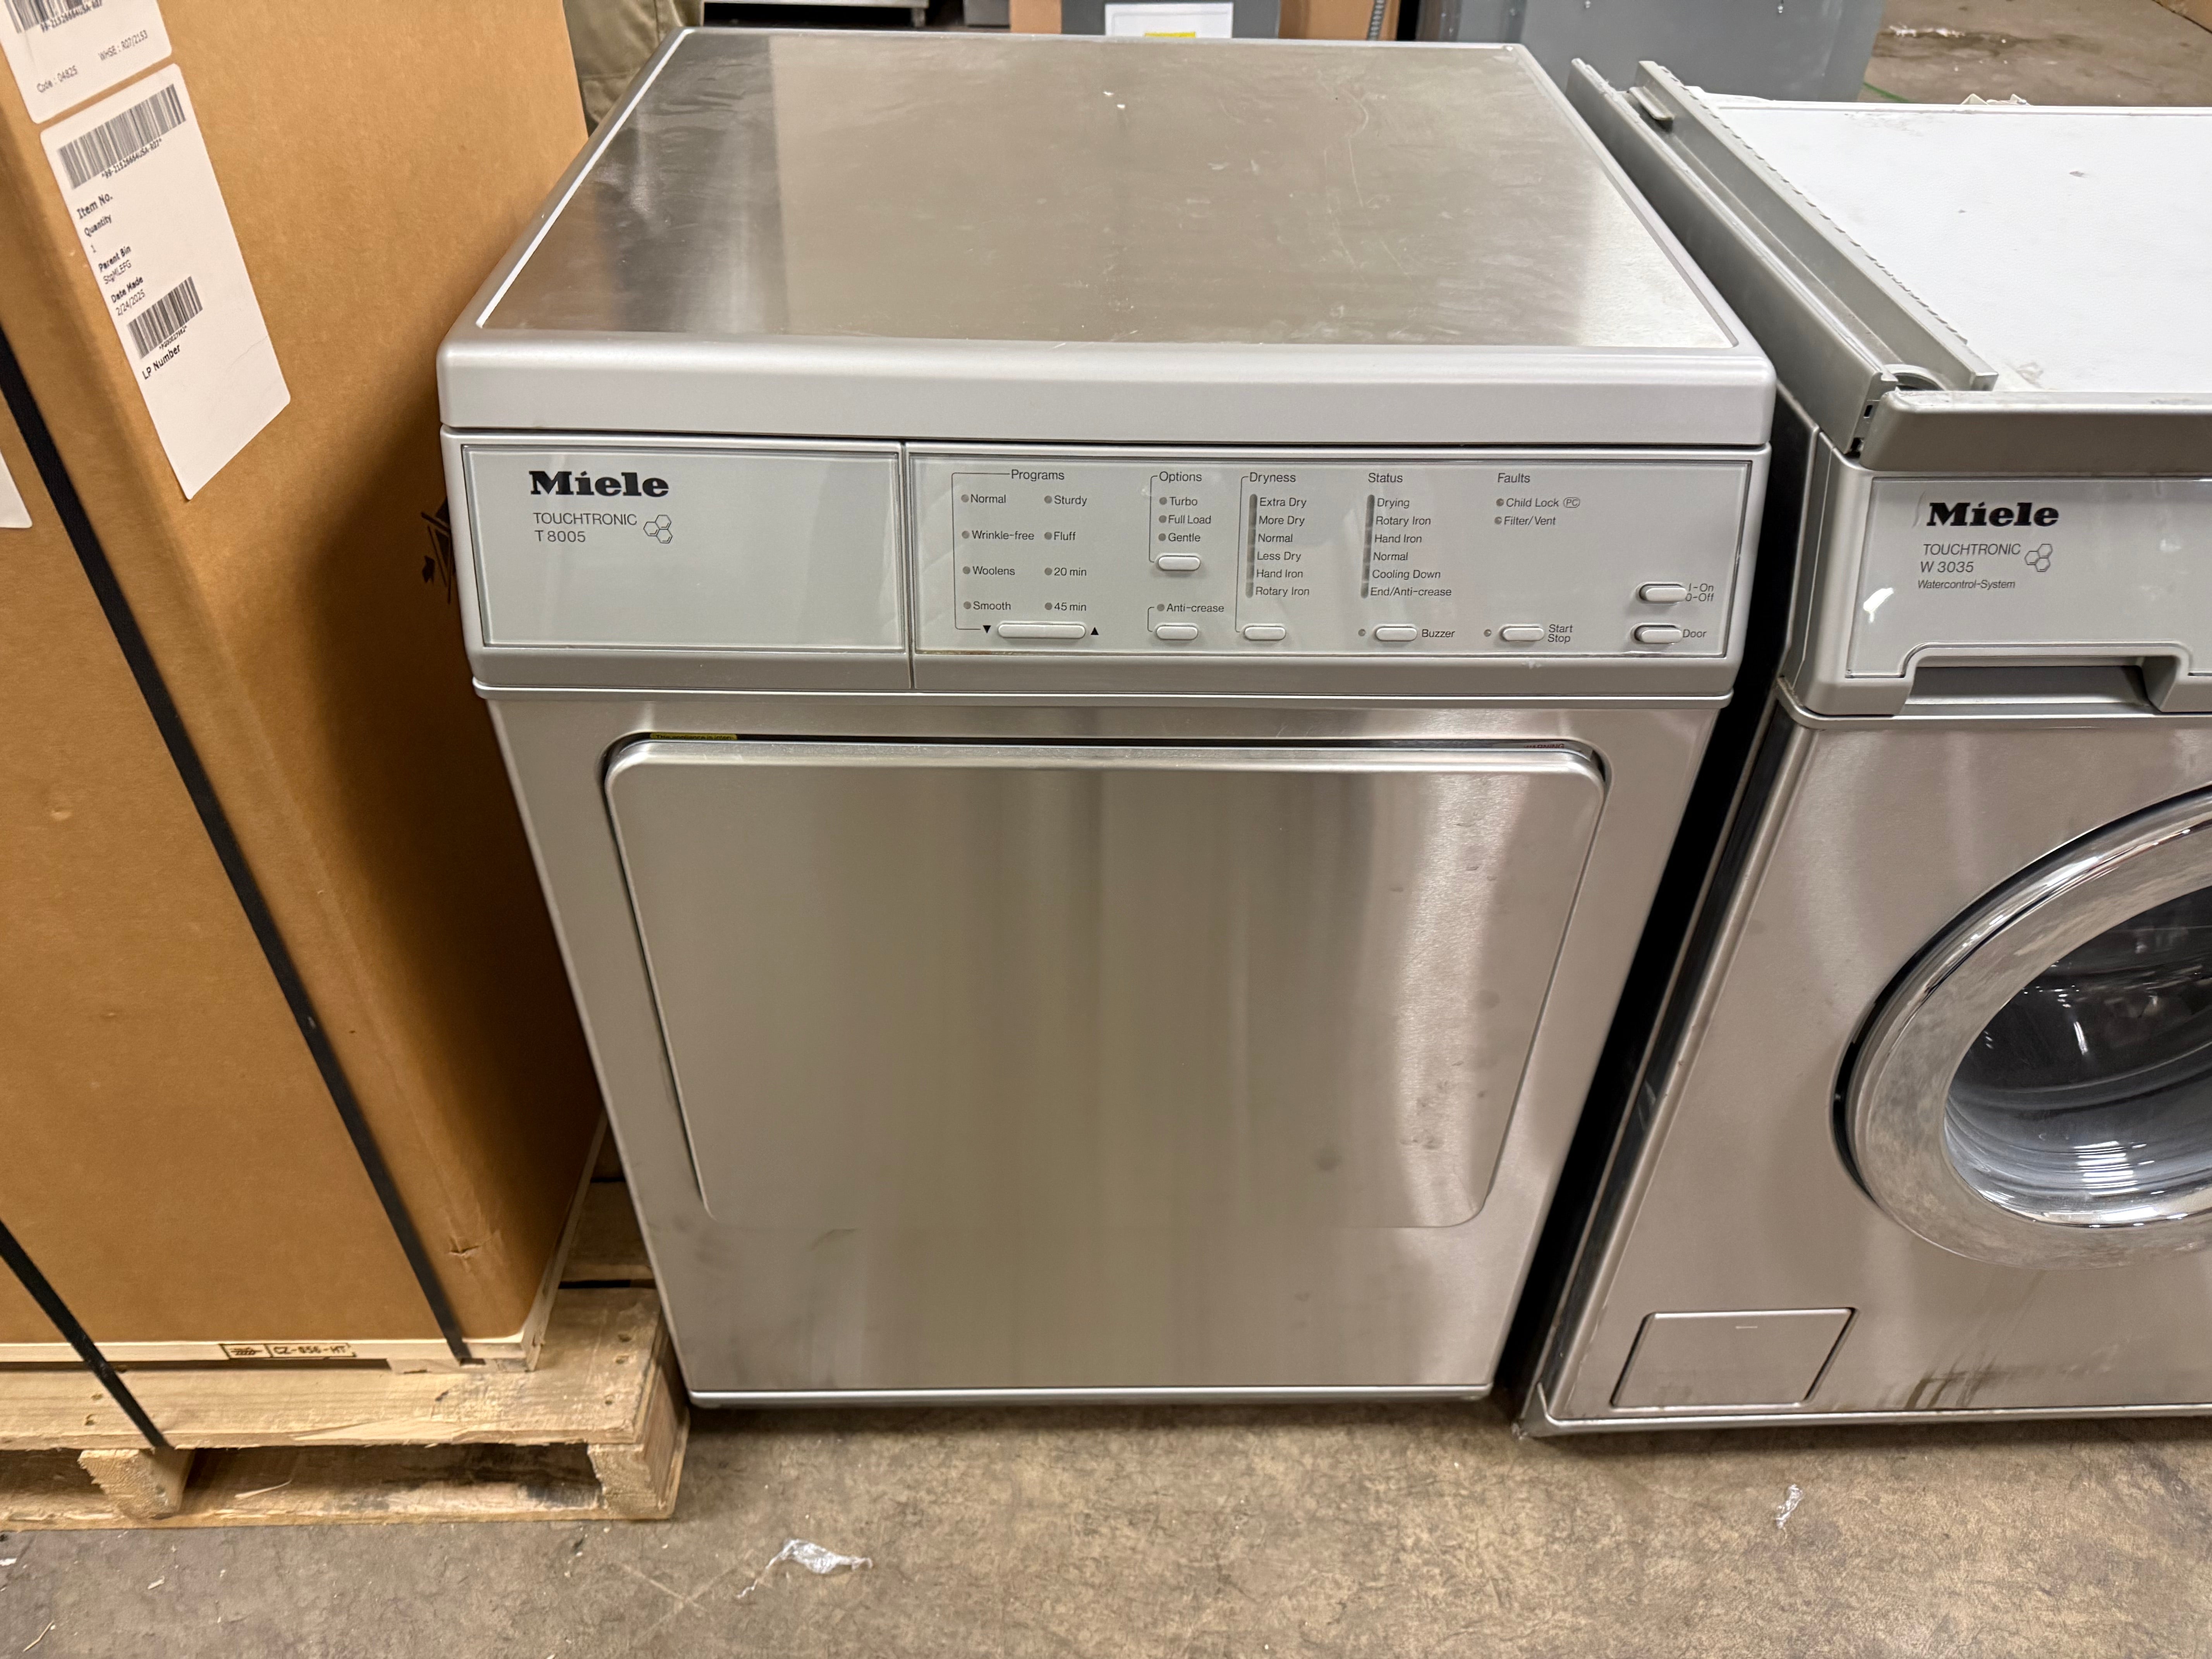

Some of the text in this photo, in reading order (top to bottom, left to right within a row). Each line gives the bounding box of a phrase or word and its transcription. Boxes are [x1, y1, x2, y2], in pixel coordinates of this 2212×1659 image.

[77, 194, 113, 219] Item No.
[84, 215, 112, 237] Quantity
[98, 246, 131, 272] Parent Bin
[111, 276, 143, 303] Date Made
[115, 289, 145, 316] 2/24/2025
[142, 345, 180, 380] LP Number
[1011, 470, 1065, 481] Programs
[1159, 472, 1202, 483] Options
[1250, 472, 1296, 484] Dryness
[1368, 472, 1403, 483] Status
[1497, 473, 1530, 483] Faults
[529, 471, 669, 497] Miele
[970, 494, 1006, 503] Normal
[1054, 495, 1087, 506] Sturdy
[1170, 497, 1197, 506] Turbo
[1260, 498, 1307, 509] Extra Dry
[1377, 498, 1410, 509] Drying
[1506, 498, 1532, 507] Child
[1535, 498, 1559, 507] Lock
[1927, 501, 2059, 527] Miele
[533, 513, 637, 526] TOUCHTRONIC
[1168, 515, 1211, 524] Full Load
[1259, 516, 1305, 527] More Dry
[1376, 516, 1431, 527] Rotary Iron
[534, 530, 586, 542] T 8005
[972, 531, 1034, 540] Wrinkle-free
[1054, 531, 1076, 541] Fluff
[1168, 533, 1200, 542] Gentle
[1258, 534, 1293, 543] Normal
[1374, 534, 1422, 543] Hand Iron
[1923, 544, 2021, 555] TOUCHTRONIC
[1257, 552, 1301, 563] Less Dry
[1373, 552, 1408, 561] Normal
[972, 566, 1015, 575] Woolens
[1054, 567, 1087, 576] 20 min
[1920, 562, 1974, 572] W 3035
[1256, 570, 1304, 579] Hand Iron
[1372, 570, 1441, 581] Cooling Down
[1918, 580, 2015, 589] Watercontrol-System
[1255, 587, 1310, 598] Rotary Iron
[1370, 587, 1451, 597] End/Anti-crease
[973, 601, 1011, 611] Smooth
[1054, 602, 1087, 611] 45 min
[1166, 604, 1224, 613] Anti-crease
[1549, 624, 1573, 633] Start
[1422, 629, 1455, 639] Buzzer
[1547, 634, 1571, 644] Stop
[1683, 630, 1707, 638] Door
